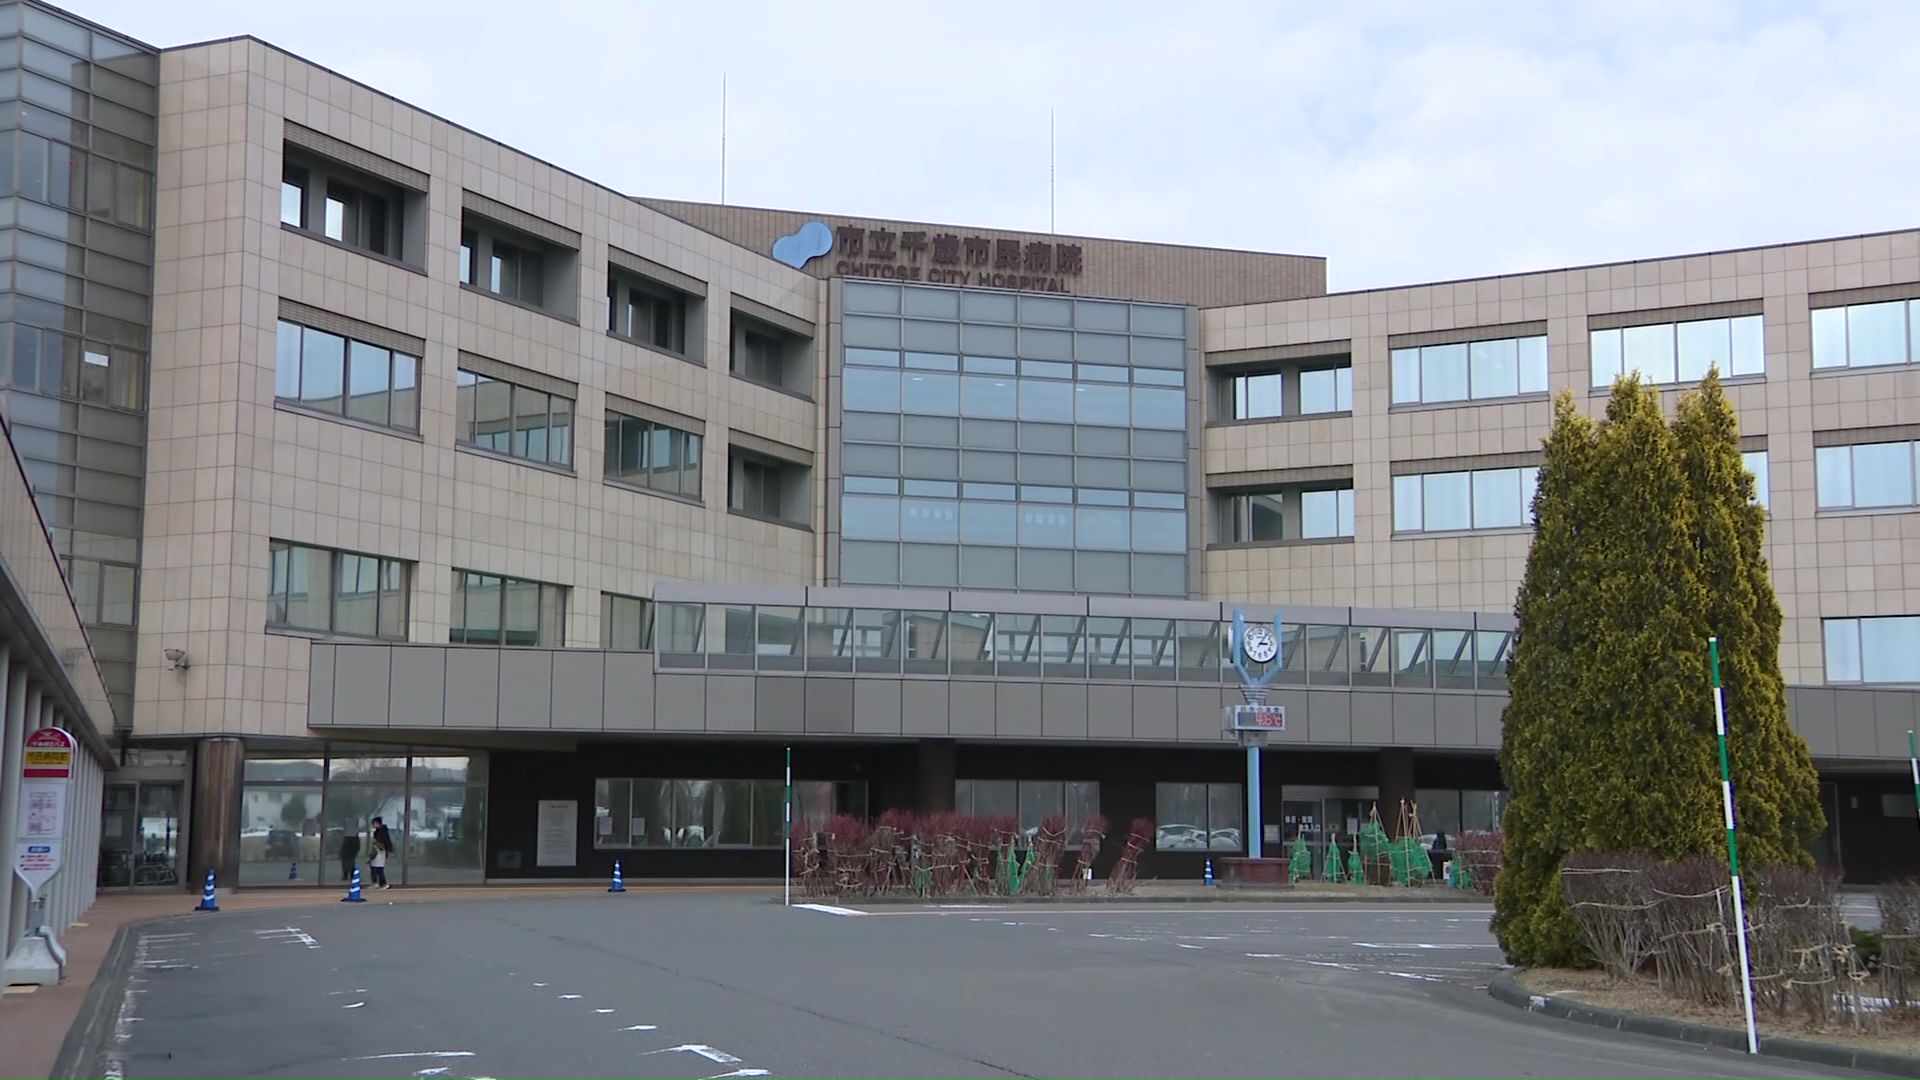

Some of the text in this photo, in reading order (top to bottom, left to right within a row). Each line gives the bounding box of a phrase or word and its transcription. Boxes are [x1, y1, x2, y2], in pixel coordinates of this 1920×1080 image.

[837, 225, 1082, 275] 市立千歳市民病院
[836, 260, 1070, 293] CHITOSE CITY HOSPITAL
